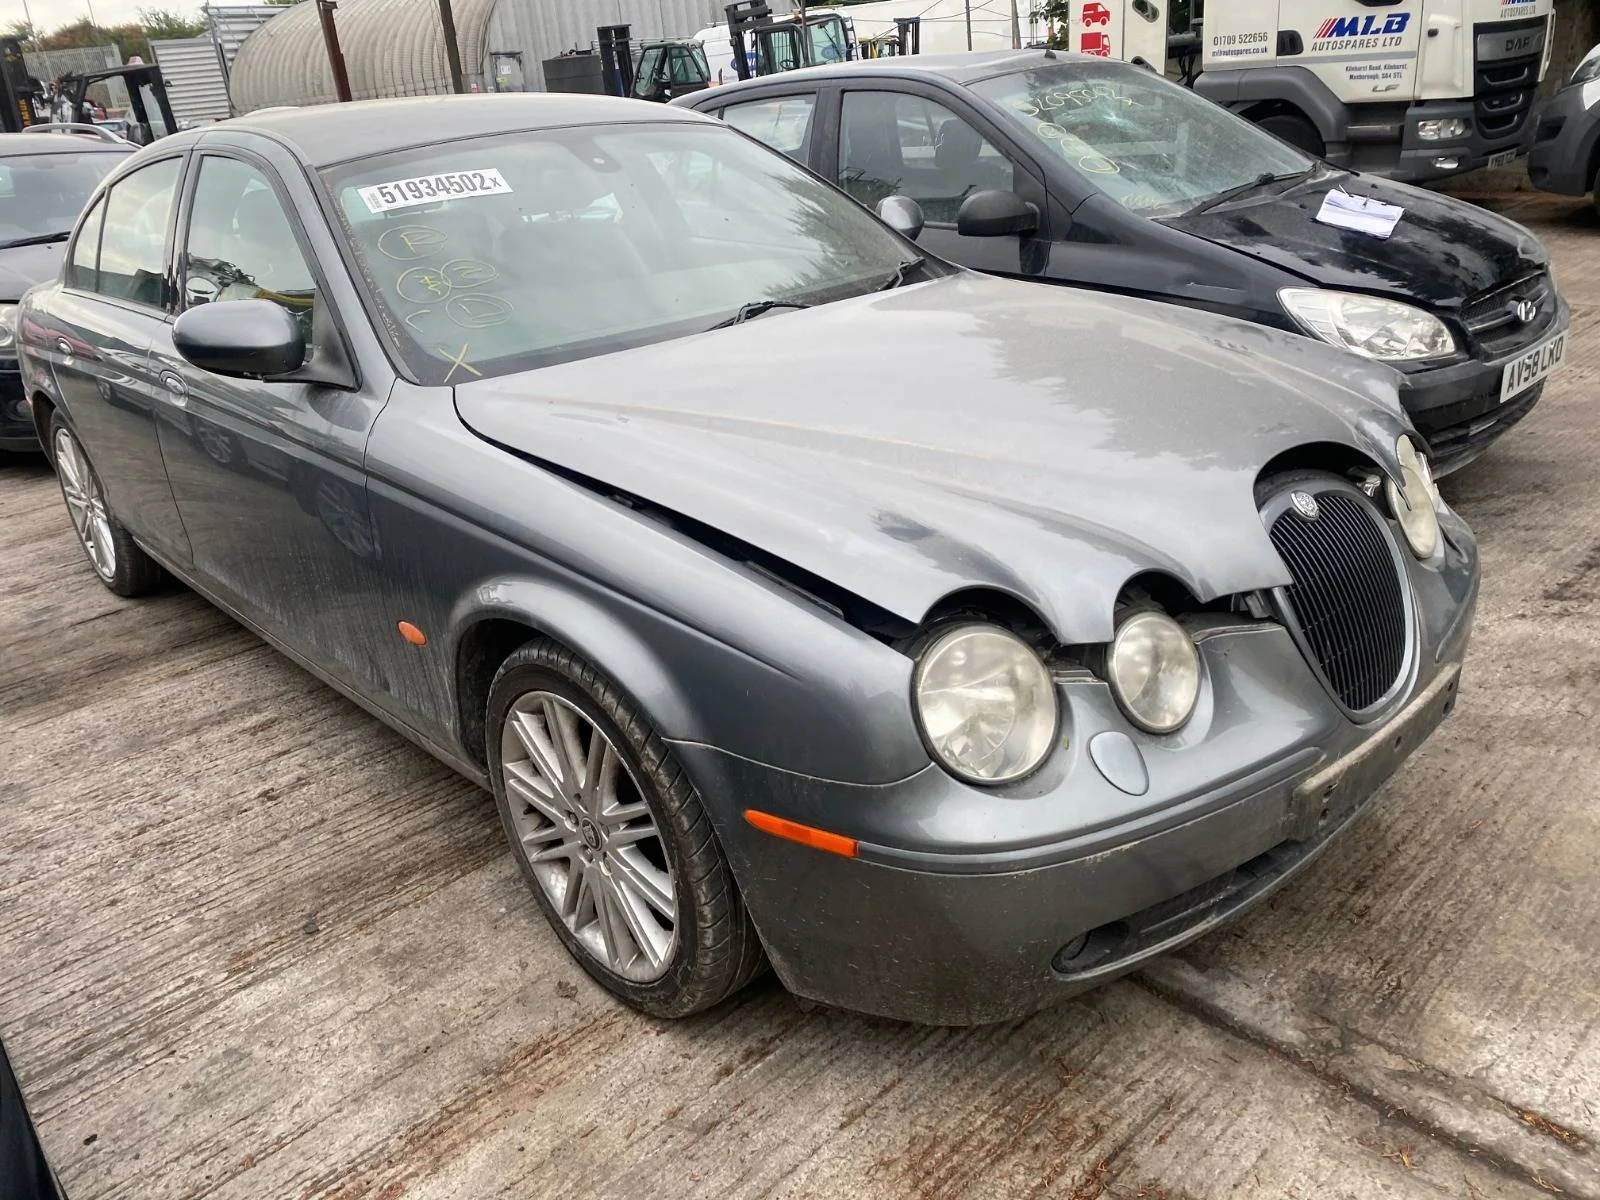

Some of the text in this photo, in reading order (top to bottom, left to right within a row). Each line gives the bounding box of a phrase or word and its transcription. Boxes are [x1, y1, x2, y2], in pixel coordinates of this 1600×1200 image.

[1328, 12, 1411, 37] MLB
[1213, 32, 1268, 46] 01709 522656
[1311, 36, 1402, 52] AUTOSPARES LTD
[1505, 37, 1530, 51] DAF
[1507, 349, 1540, 393] AV58
